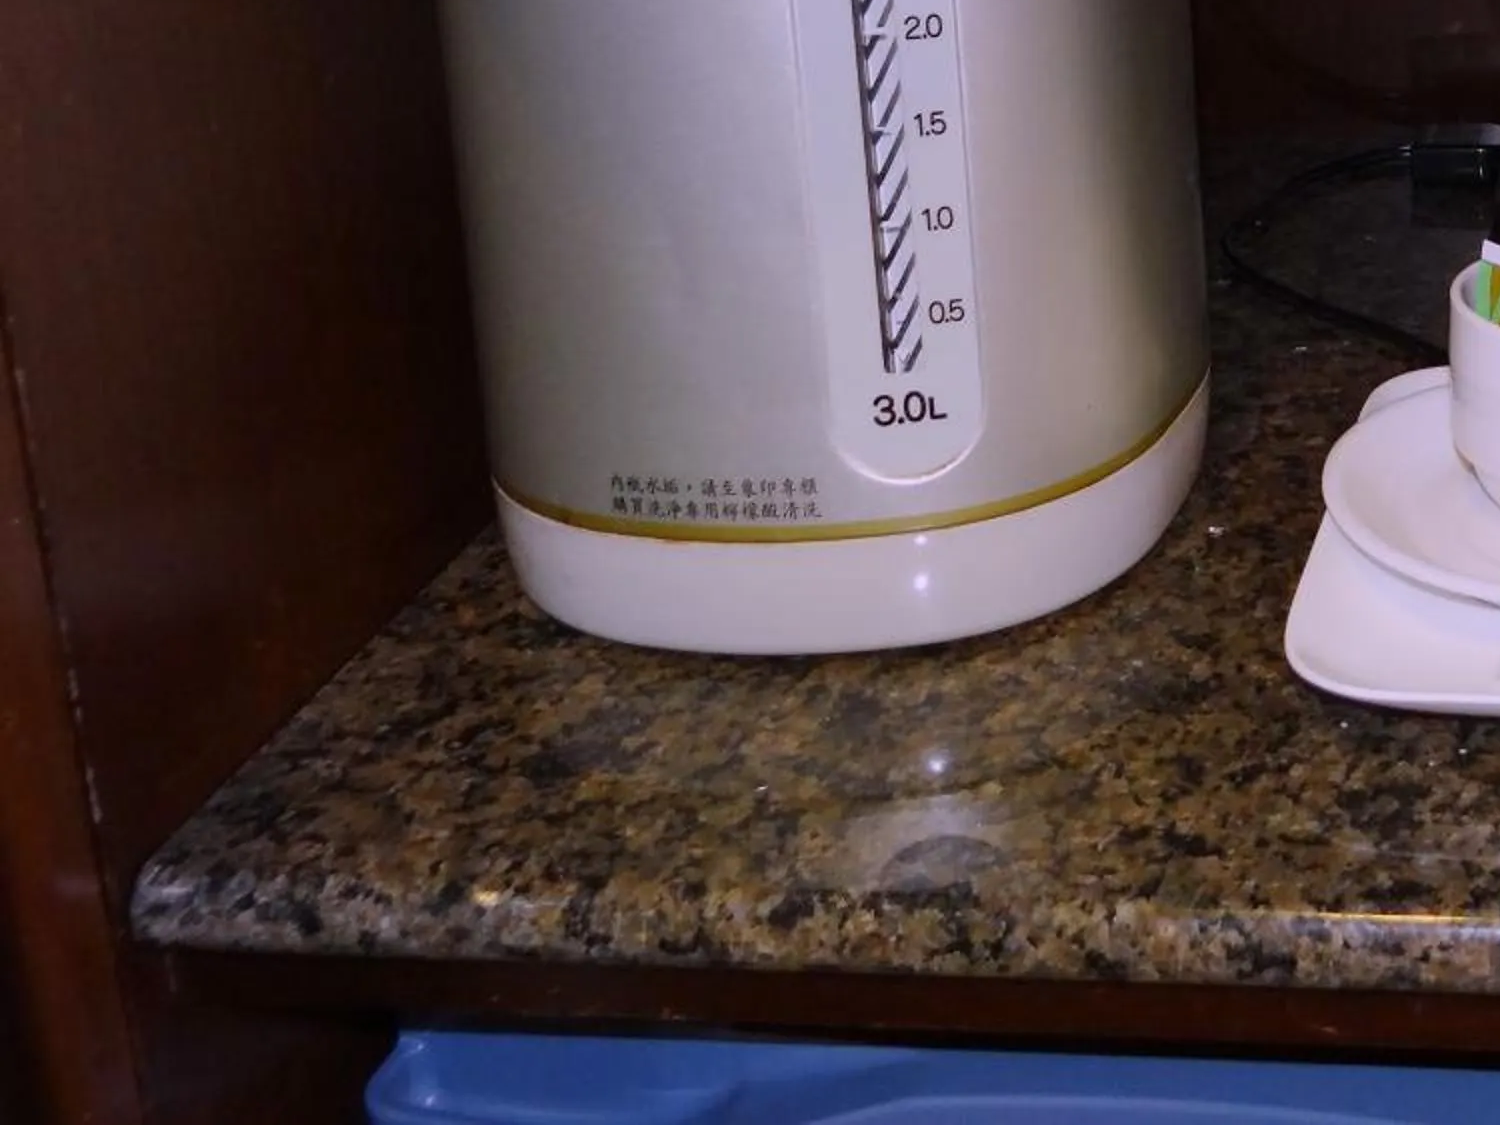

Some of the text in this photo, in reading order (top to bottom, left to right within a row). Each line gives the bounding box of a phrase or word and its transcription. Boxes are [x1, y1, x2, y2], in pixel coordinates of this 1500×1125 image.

[904, 14, 943, 39] 2.0
[914, 111, 947, 137] 1.5
[921, 206, 954, 231] 1.0
[928, 299, 965, 324] 0.5
[873, 392, 948, 425] 3.0L
